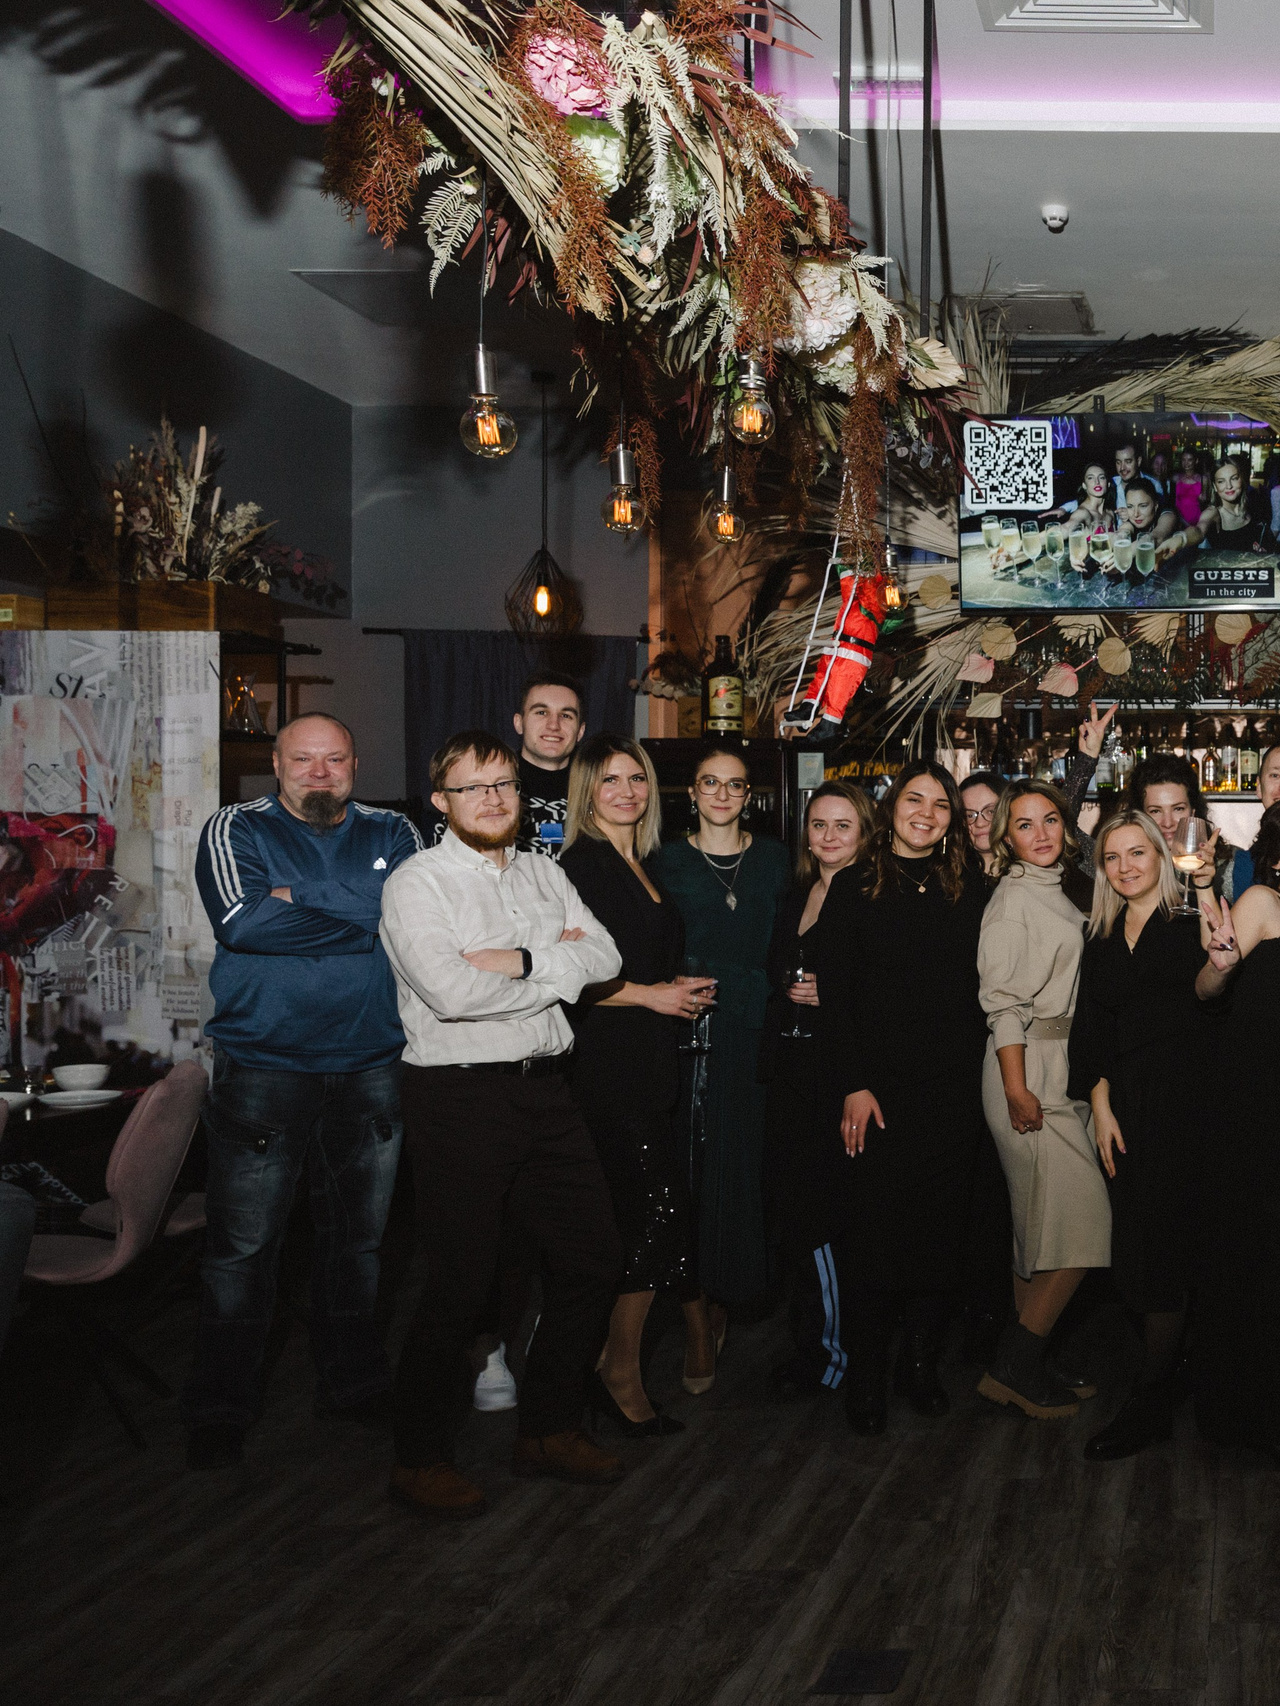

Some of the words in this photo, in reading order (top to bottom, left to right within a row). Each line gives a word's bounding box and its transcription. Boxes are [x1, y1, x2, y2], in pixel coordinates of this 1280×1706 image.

[1193, 570, 1269, 581] GUESTS
[1206, 588, 1216, 596] In
[1219, 588, 1235, 596] the
[1238, 588, 1257, 598] city
